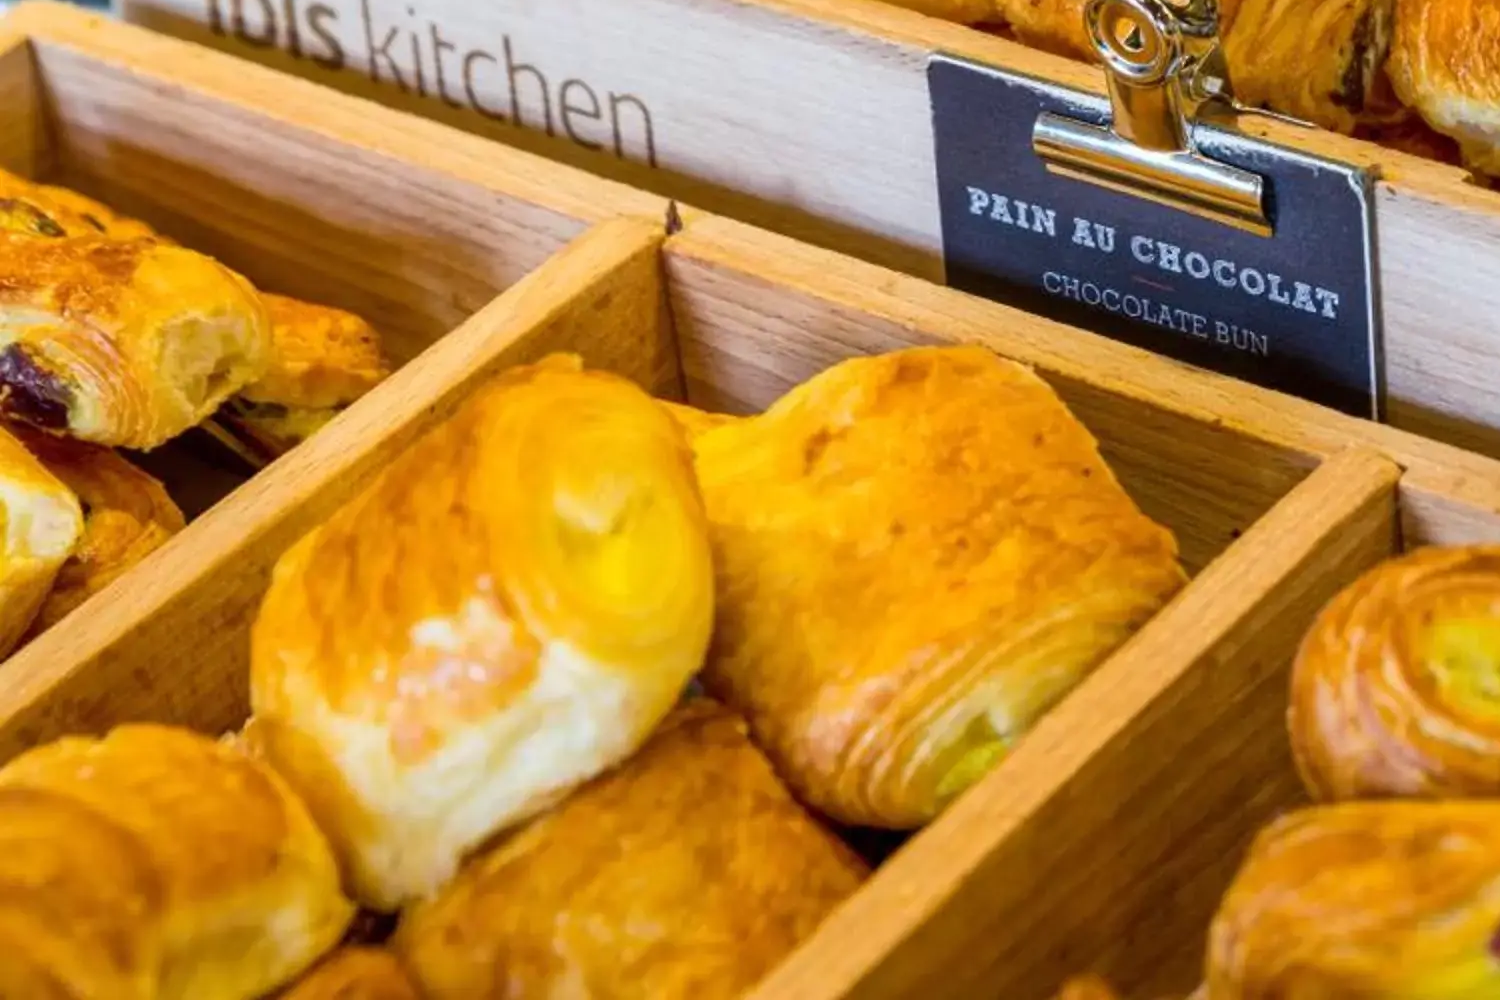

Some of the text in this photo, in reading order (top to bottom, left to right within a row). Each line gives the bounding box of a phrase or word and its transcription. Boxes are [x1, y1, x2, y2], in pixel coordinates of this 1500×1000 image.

[965, 186, 1339, 319] PAIN AU CHOCOLAT
[1043, 271, 1269, 357] CHOCOLATE BUN
